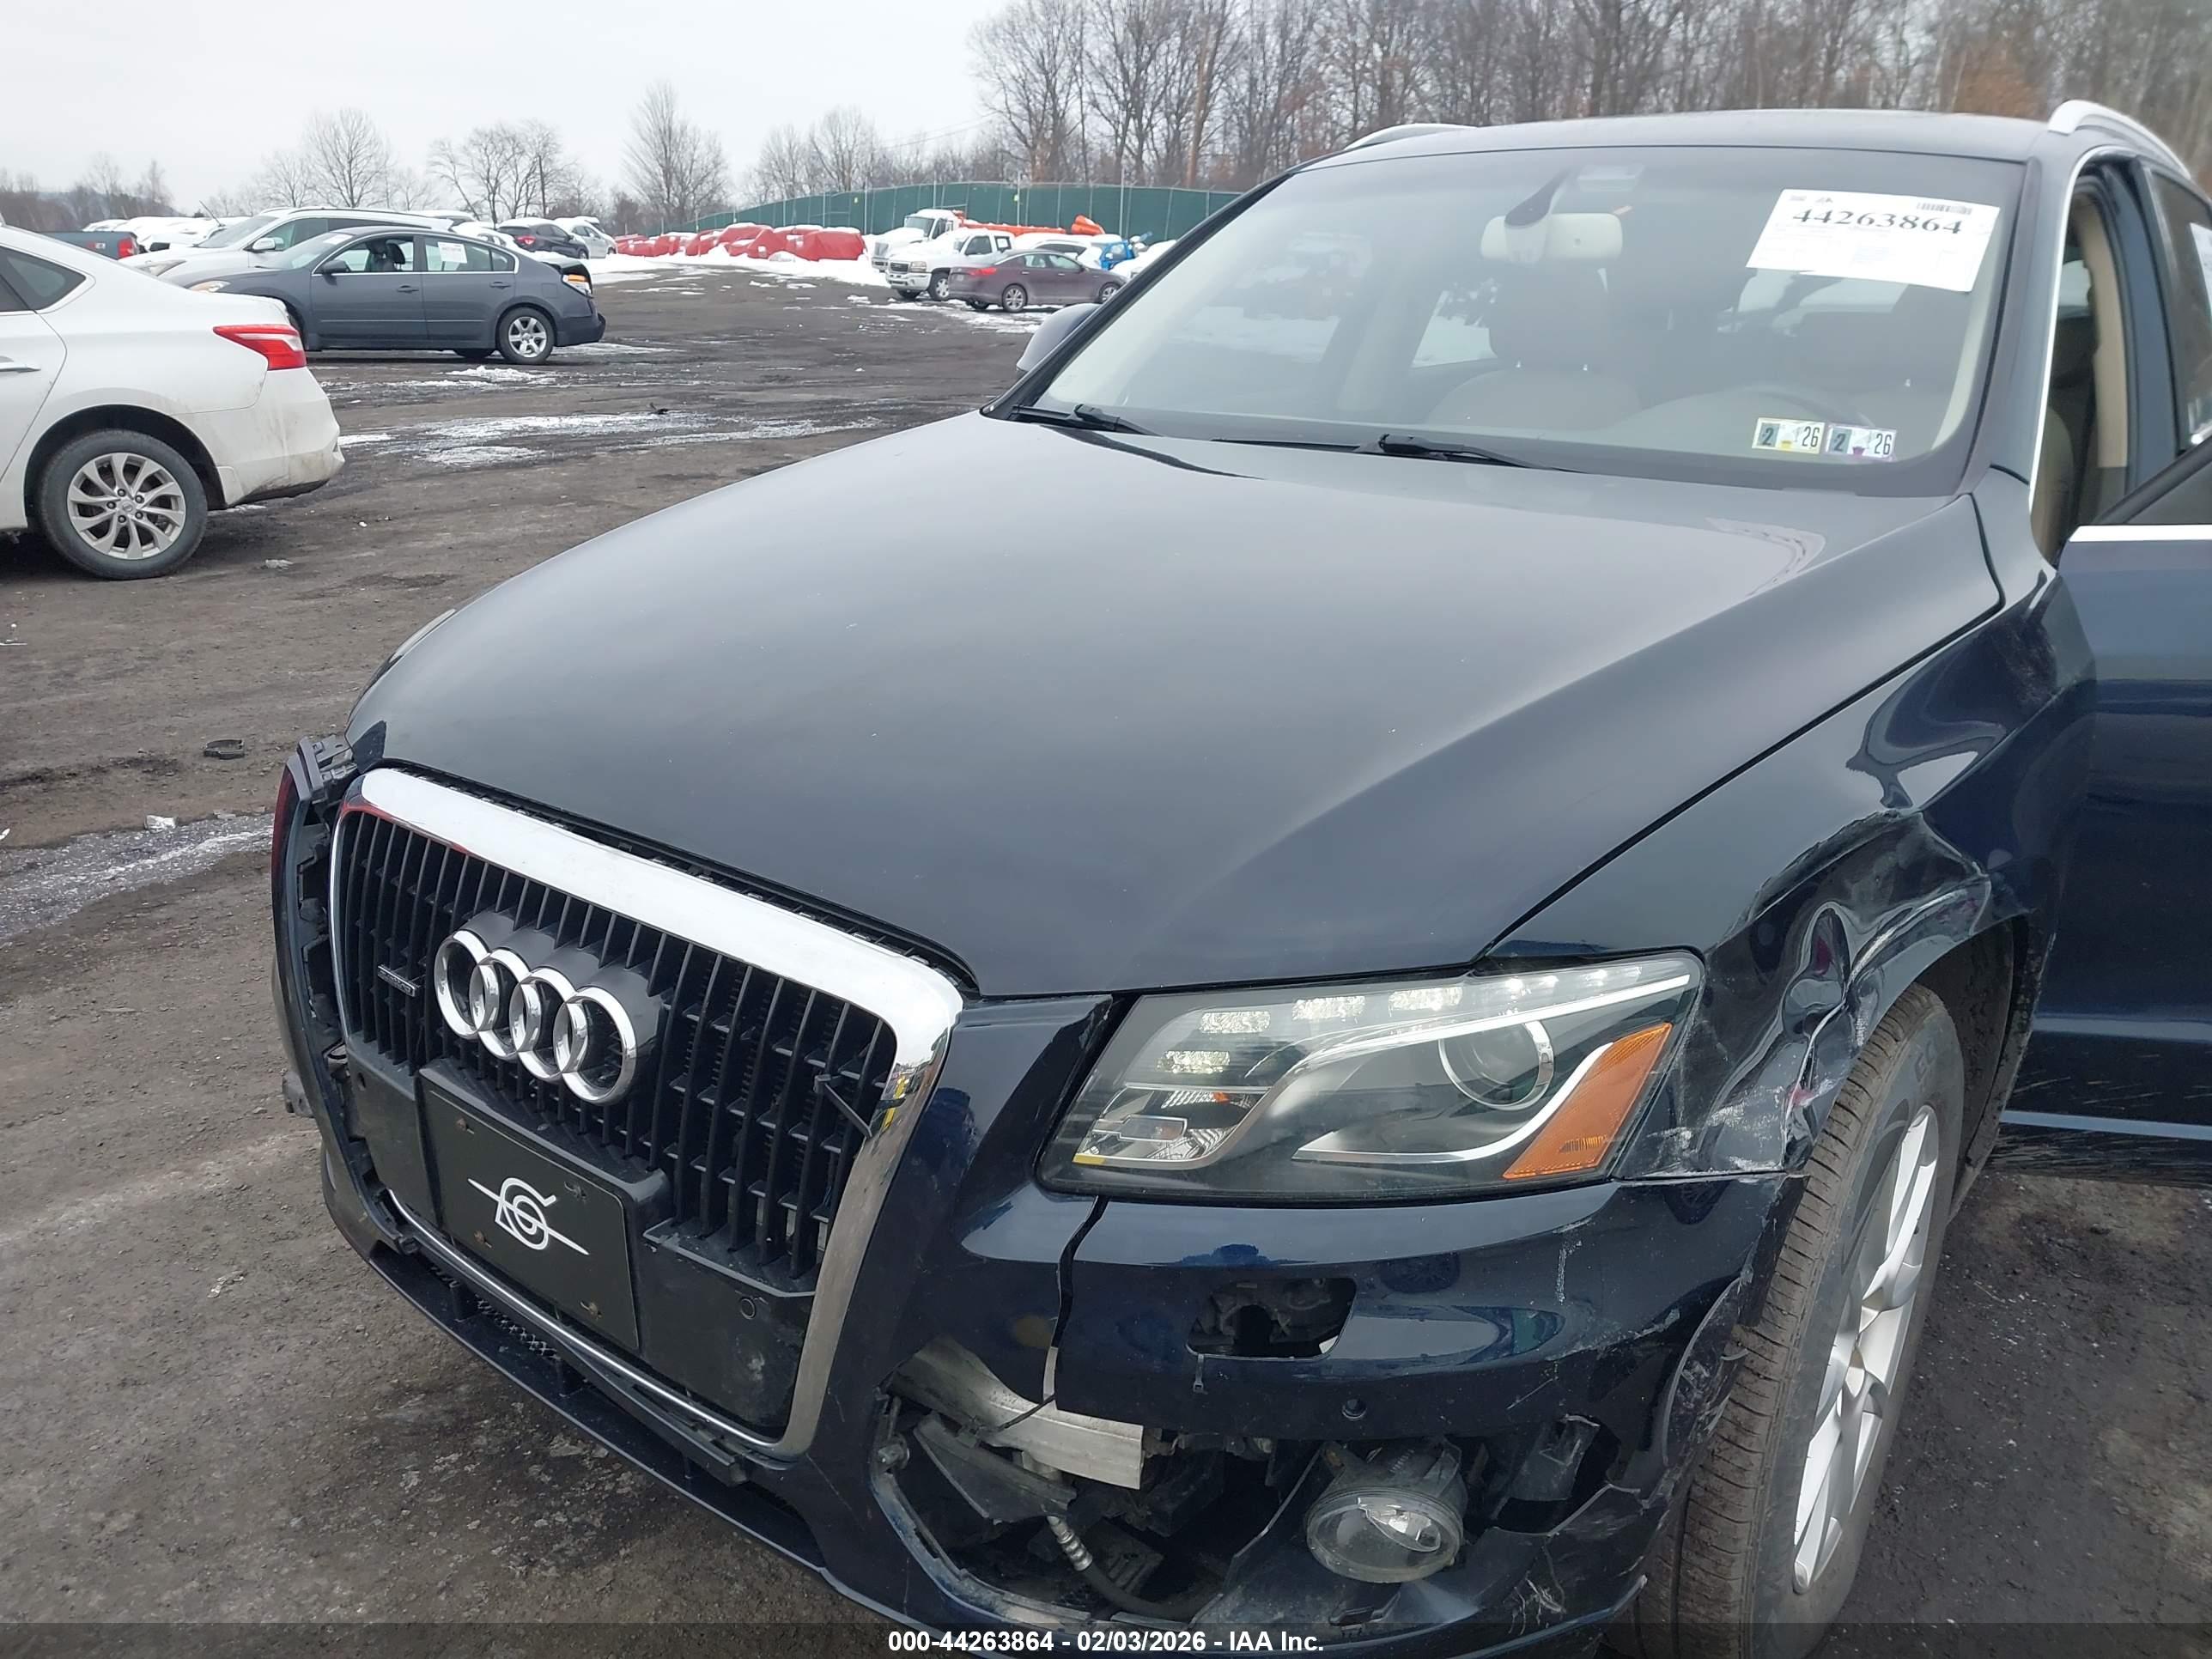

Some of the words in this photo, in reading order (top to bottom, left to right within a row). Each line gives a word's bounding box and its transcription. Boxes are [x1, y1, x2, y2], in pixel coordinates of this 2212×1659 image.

[1792, 209, 1963, 234] 44263864
[1762, 428, 1774, 447] 2
[1802, 426, 1820, 447] 26
[1833, 433, 1846, 452] 2
[1874, 433, 1893, 455] 26
